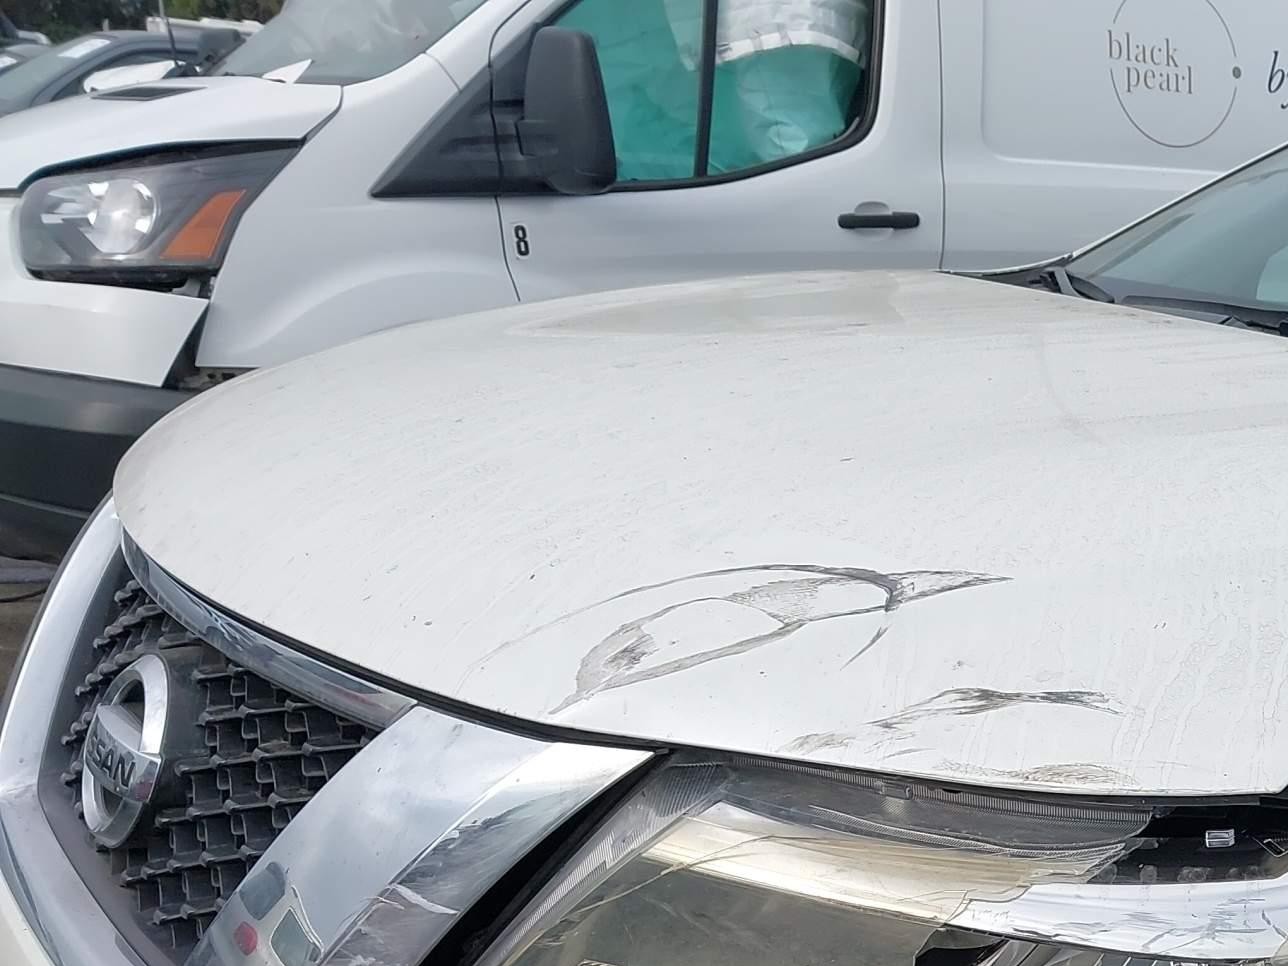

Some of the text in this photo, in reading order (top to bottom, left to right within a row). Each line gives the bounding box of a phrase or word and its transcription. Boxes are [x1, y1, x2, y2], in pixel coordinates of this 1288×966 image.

[1107, 29, 1179, 68] black
[1126, 65, 1193, 94] pearl
[514, 224, 529, 256] 8
